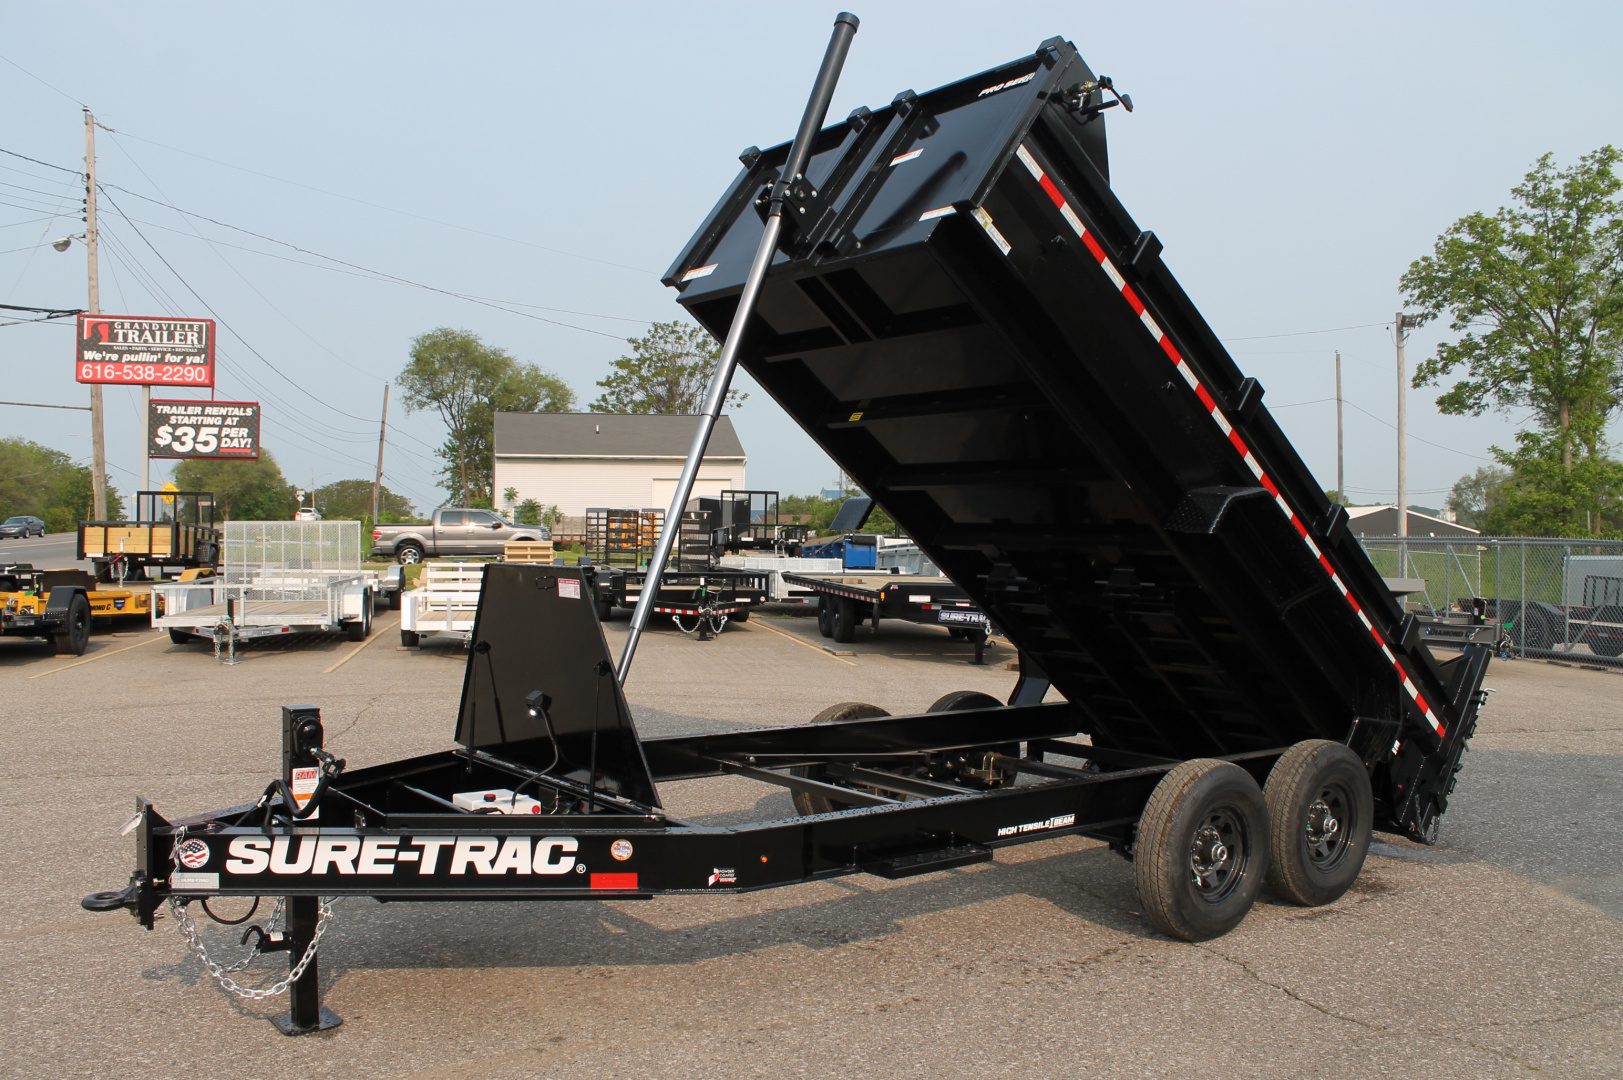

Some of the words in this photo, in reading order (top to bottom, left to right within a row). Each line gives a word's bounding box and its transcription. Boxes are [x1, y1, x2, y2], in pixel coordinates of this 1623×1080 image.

[114, 321, 200, 332] GRANDVILLE
[113, 329, 199, 344] TRAILER
[83, 350, 119, 361] We're
[121, 352, 161, 363] pullin'
[164, 353, 183, 363] for
[185, 354, 205, 365] ya!
[81, 363, 206, 382] 616-538-2290
[156, 405, 203, 415] TRAILER
[204, 406, 253, 416] RENTALS
[169, 415, 222, 425] STARTING
[224, 416, 240, 426] AT
[154, 423, 220, 453] $35
[220, 427, 249, 438] PER
[220, 437, 252, 448] DAY!
[997, 825, 1018, 837] HIGH
[1018, 819, 1050, 833] TENSILE
